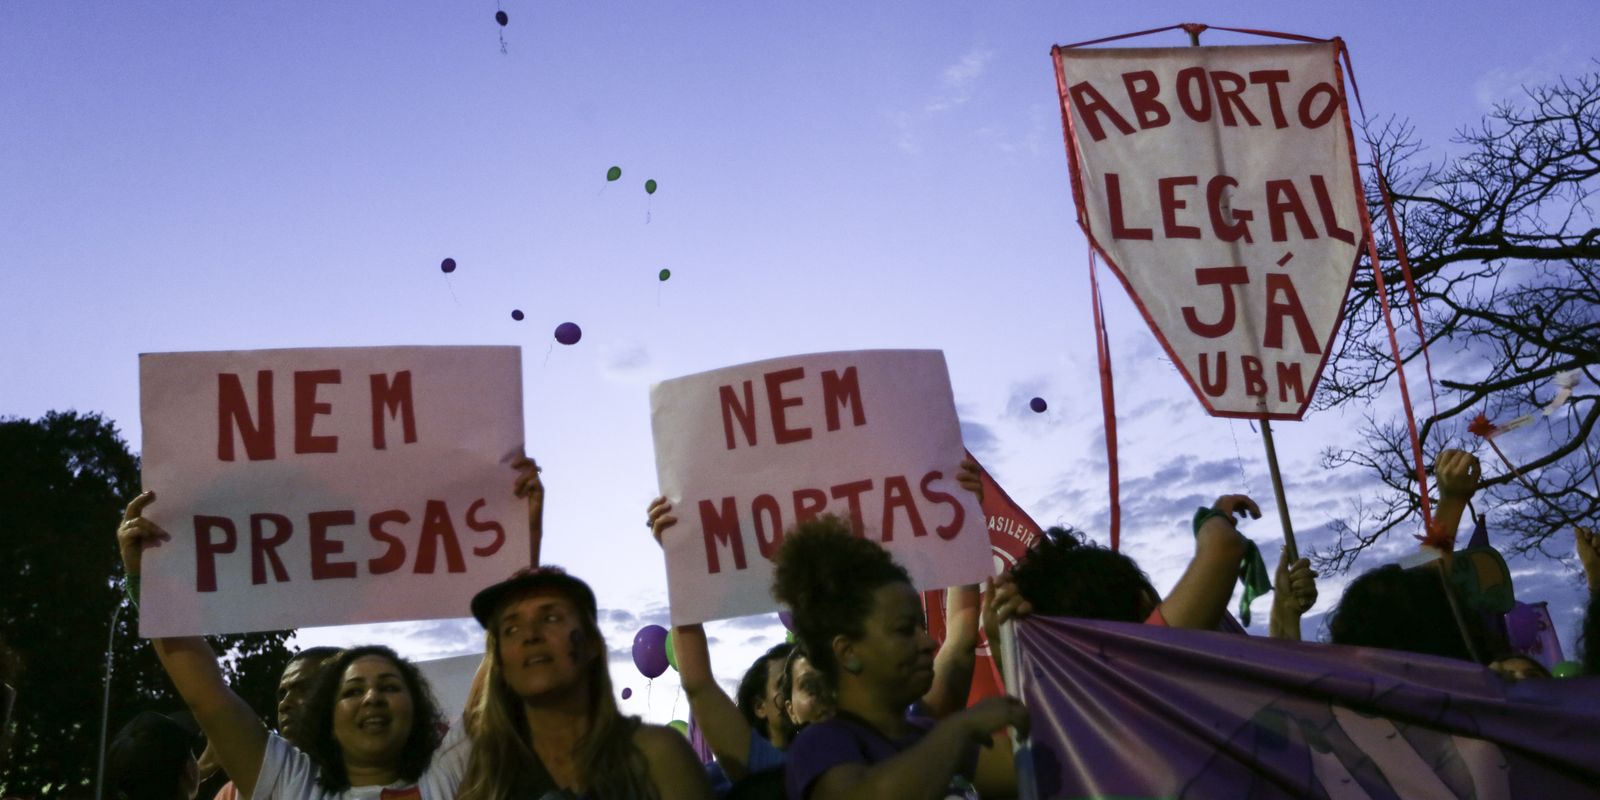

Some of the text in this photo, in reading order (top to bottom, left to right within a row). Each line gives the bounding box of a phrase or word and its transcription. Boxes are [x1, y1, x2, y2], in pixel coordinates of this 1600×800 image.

[1069, 67, 1341, 142] ABORTO
[1104, 173, 1356, 246] LEGAL
[1181, 252, 1322, 355] JÁ
[217, 370, 417, 462] NEM
[719, 366, 866, 450] NEM
[1199, 351, 1301, 403] UBM
[193, 498, 505, 593] PRESAS
